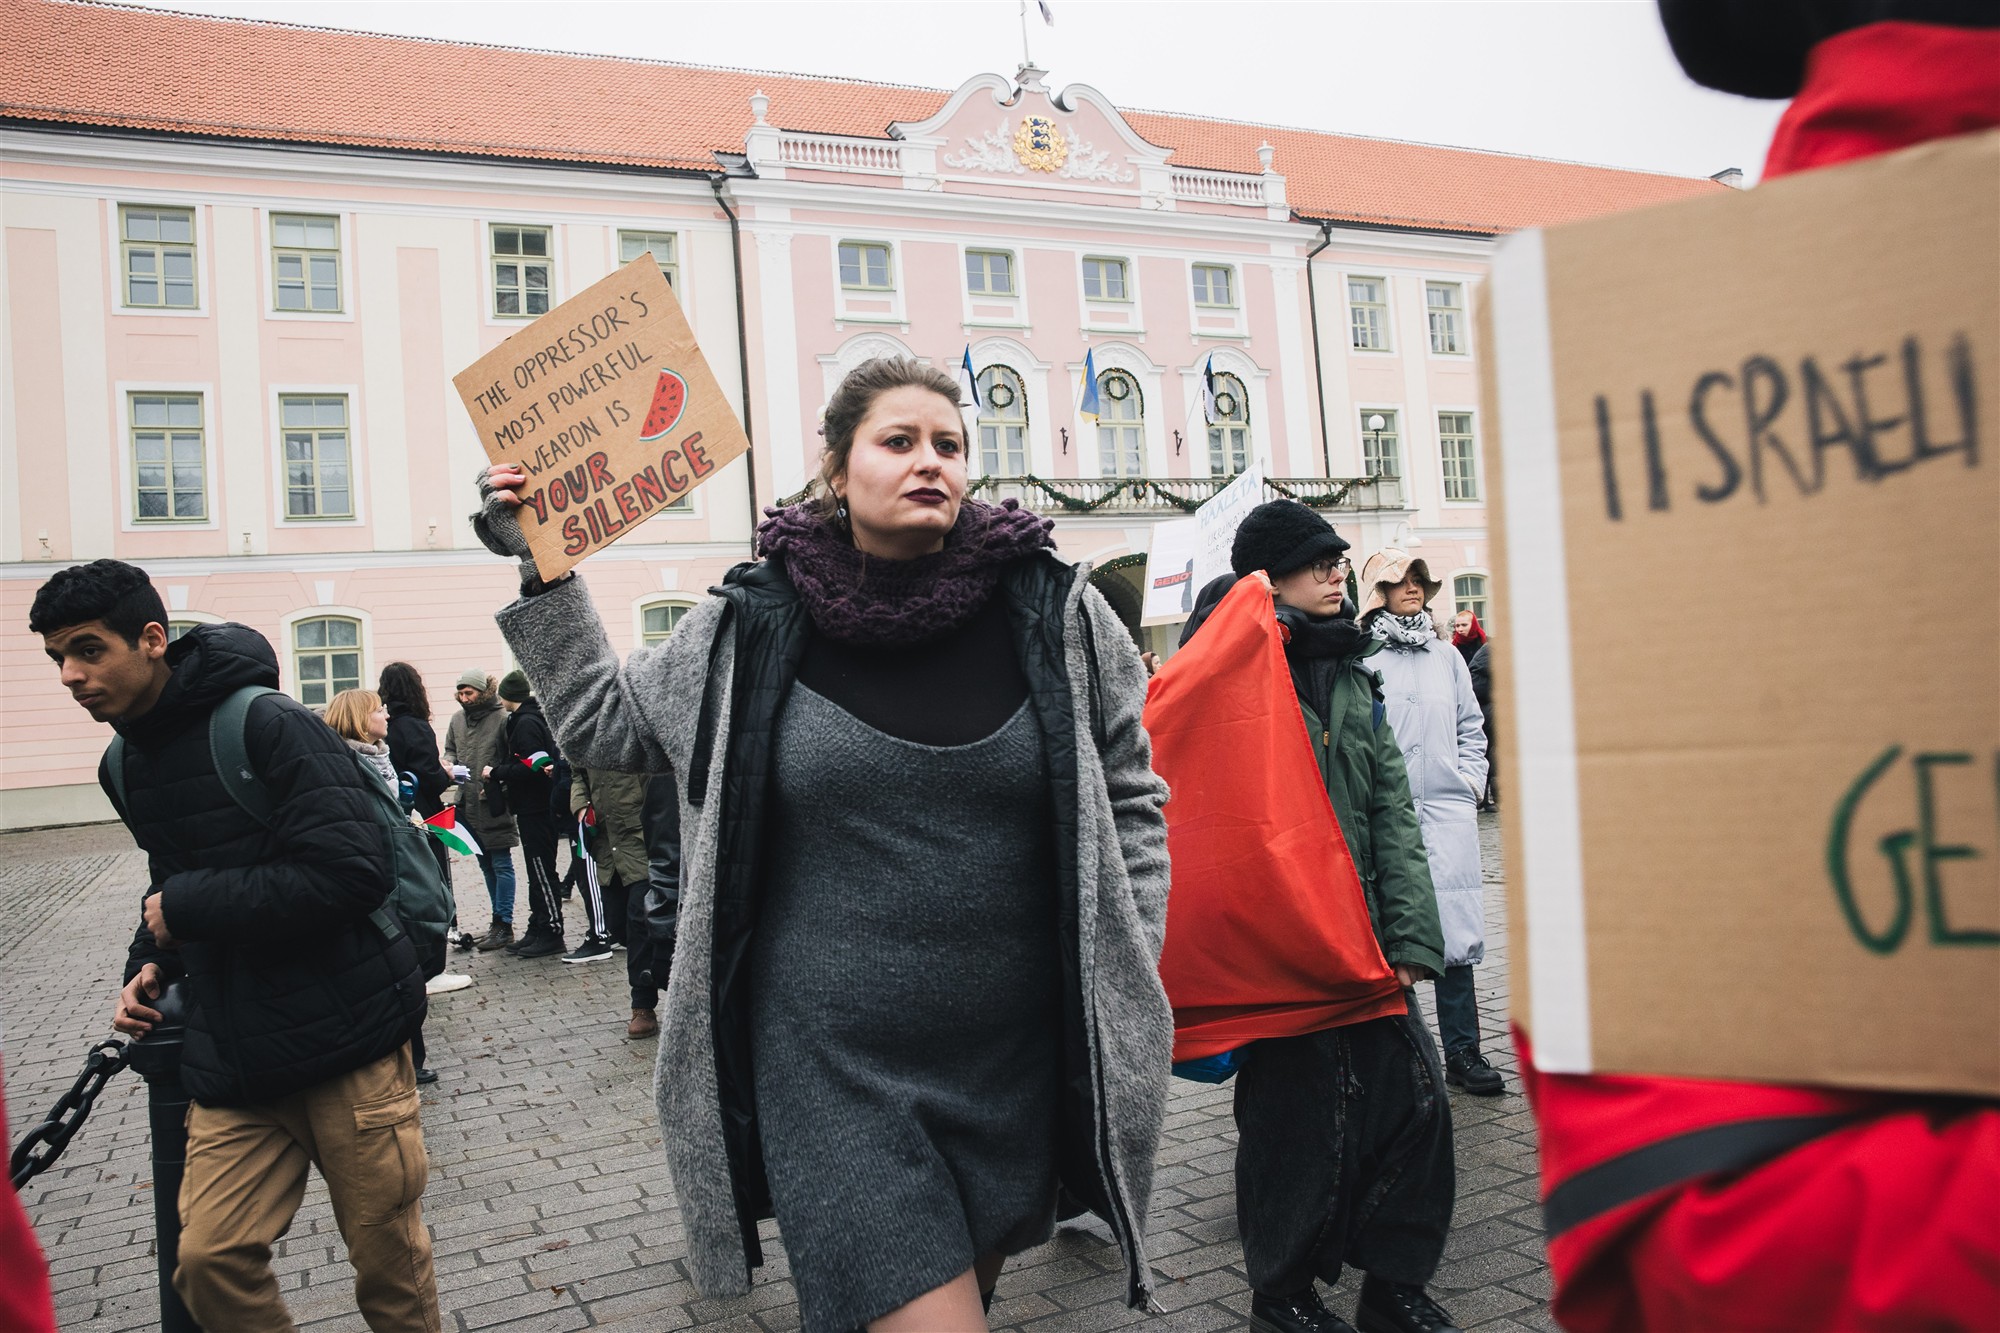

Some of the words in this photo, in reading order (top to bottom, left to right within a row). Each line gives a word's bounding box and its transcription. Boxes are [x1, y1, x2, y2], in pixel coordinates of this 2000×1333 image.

[473, 380, 512, 416] THE
[513, 291, 649, 390] OPPRESSOR'S
[494, 406, 546, 451] MOST
[547, 341, 653, 416] POWERFUL
[521, 415, 601, 477] WEAPON
[605, 400, 631, 428] IS
[521, 451, 616, 526] YOUR
[561, 431, 716, 557] SILENCE
[1154, 571, 1192, 587] GENO
[1825, 743, 2000, 956] GE
